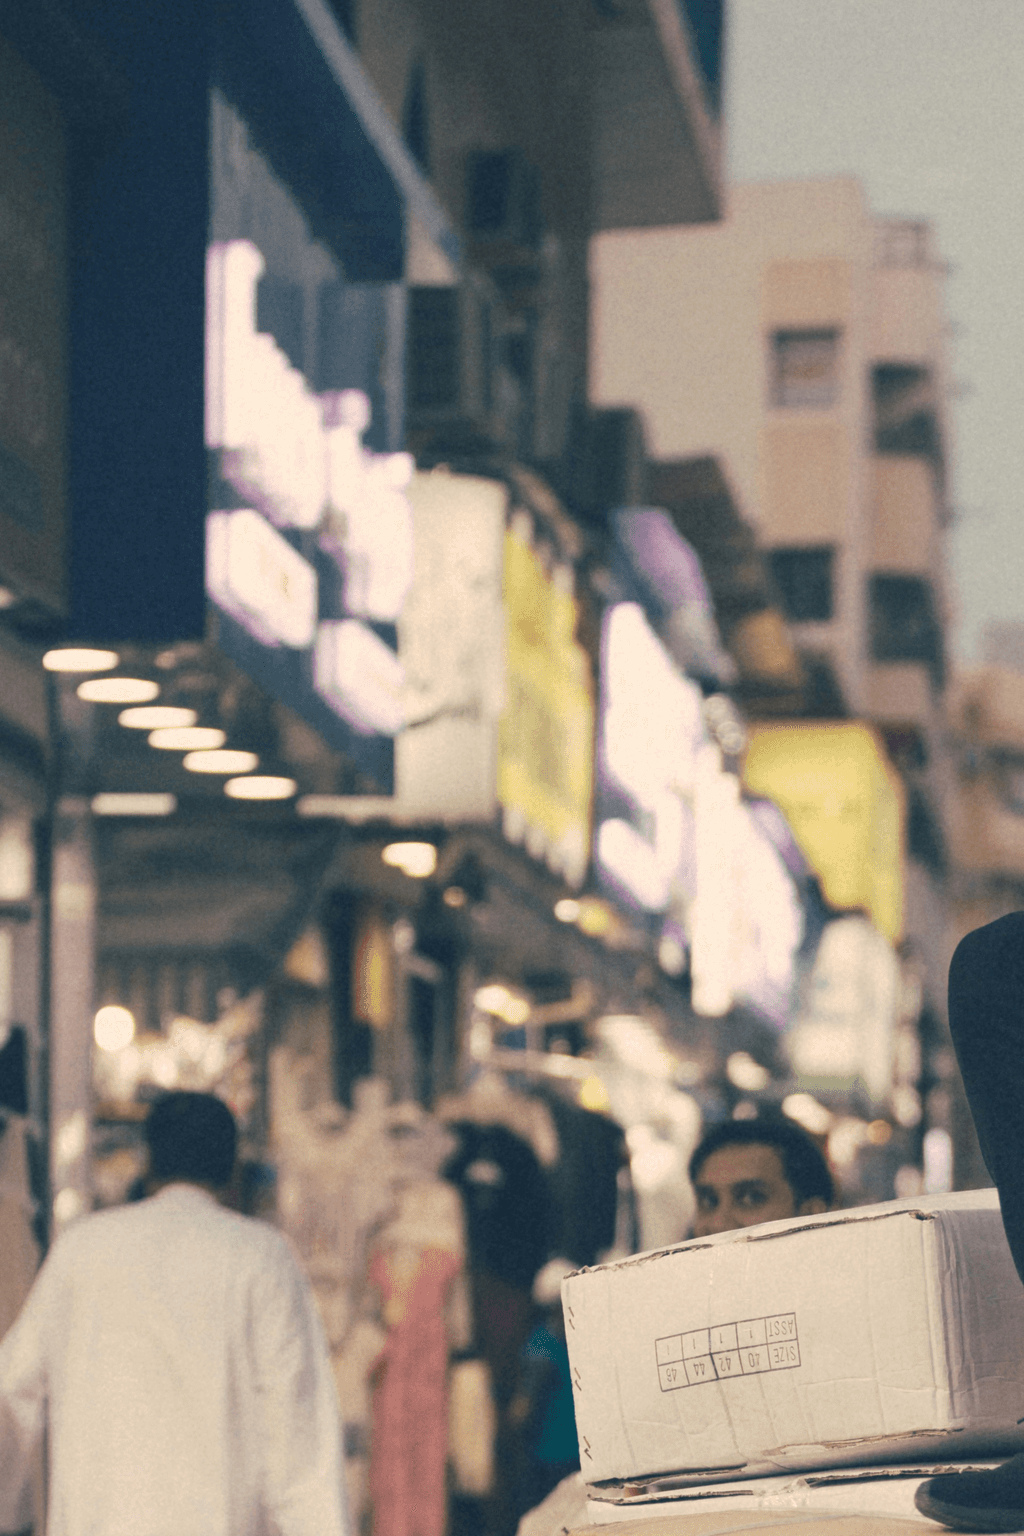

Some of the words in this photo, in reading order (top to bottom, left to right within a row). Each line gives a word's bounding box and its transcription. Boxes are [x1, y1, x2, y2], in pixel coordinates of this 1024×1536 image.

[768, 1319, 794, 1337] ASST
[748, 1352, 760, 1368] 40
[773, 1345, 796, 1364] SIZE
[692, 1361, 706, 1377] 44
[718, 1356, 732, 1372] 42
[665, 1367, 678, 1383] 46
